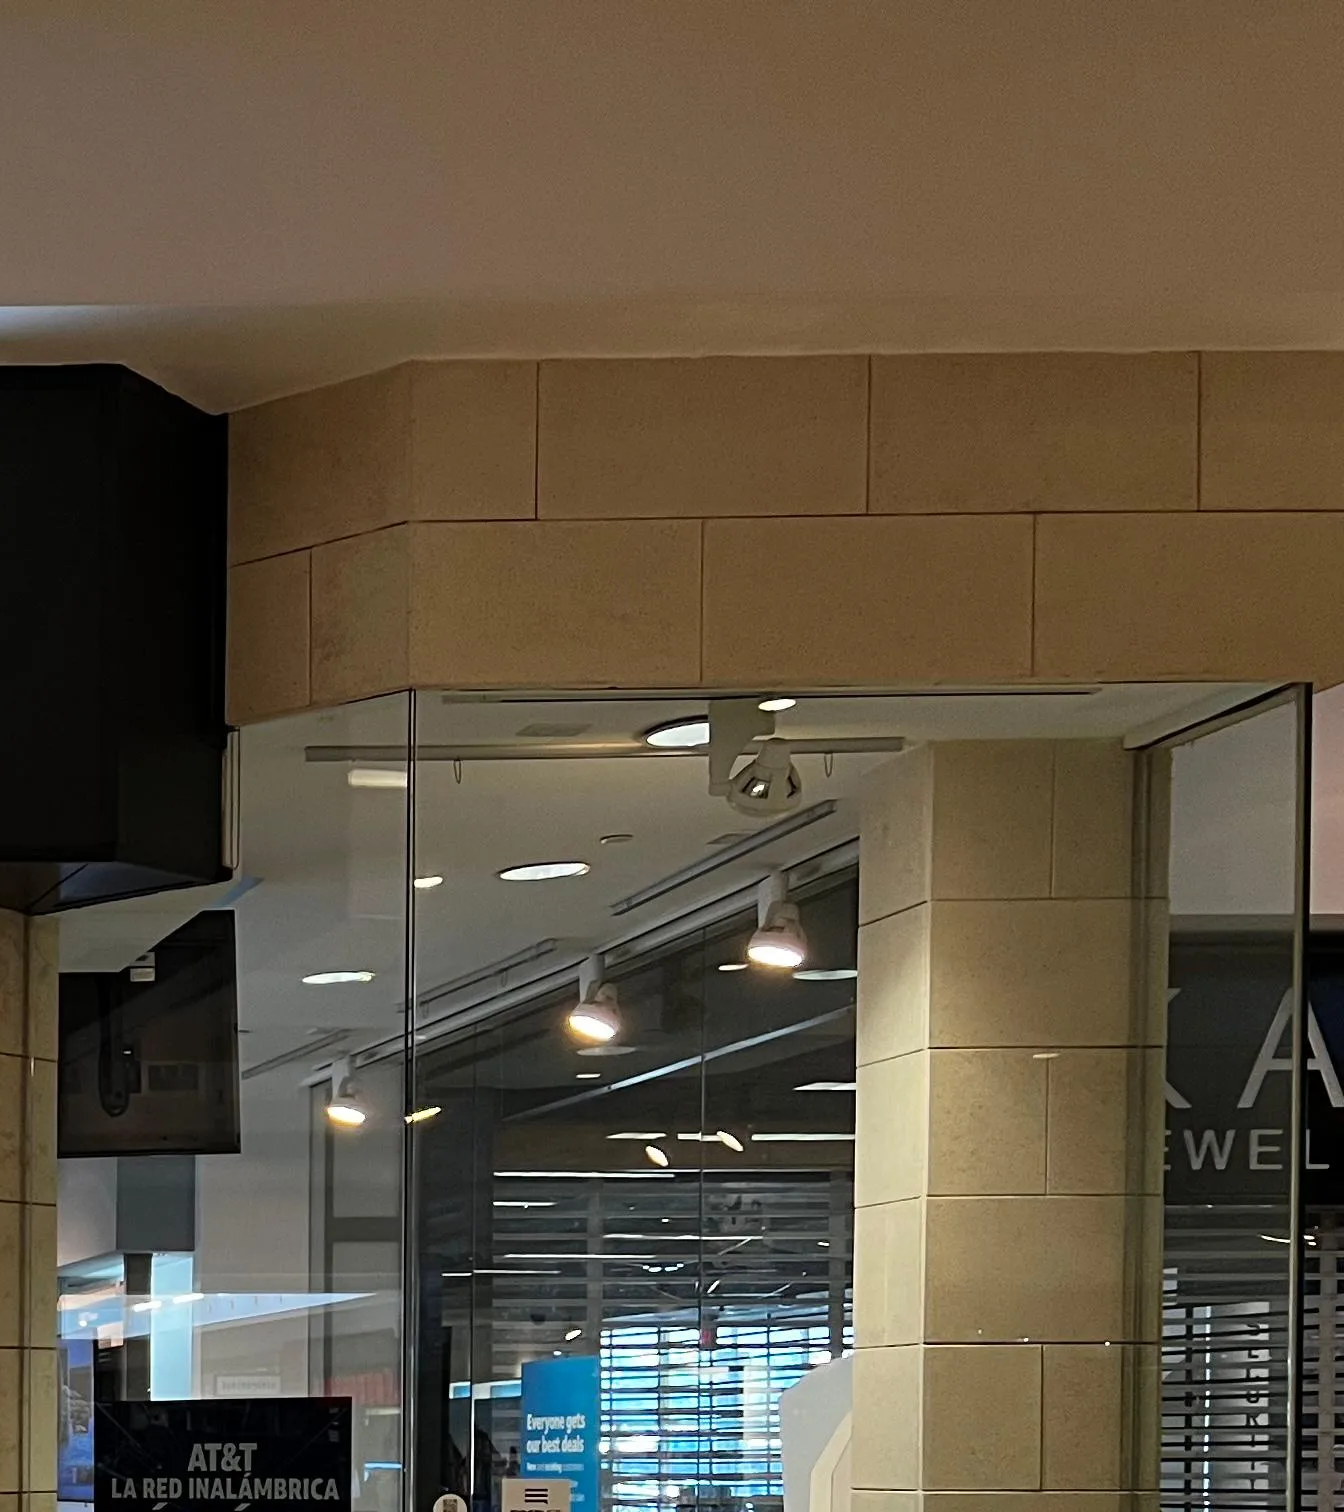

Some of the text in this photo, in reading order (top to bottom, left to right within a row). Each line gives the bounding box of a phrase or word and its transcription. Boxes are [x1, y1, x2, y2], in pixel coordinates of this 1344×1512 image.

[1164, 986, 1344, 1108] A
[1164, 1129, 1330, 1170] WEL
[526, 1413, 586, 1435] Everyone gets
[187, 1442, 258, 1472] AT&T
[541, 1435, 561, 1453] best
[561, 1434, 584, 1453] deals
[112, 1473, 340, 1501] LA RED INALÁMBRICA
